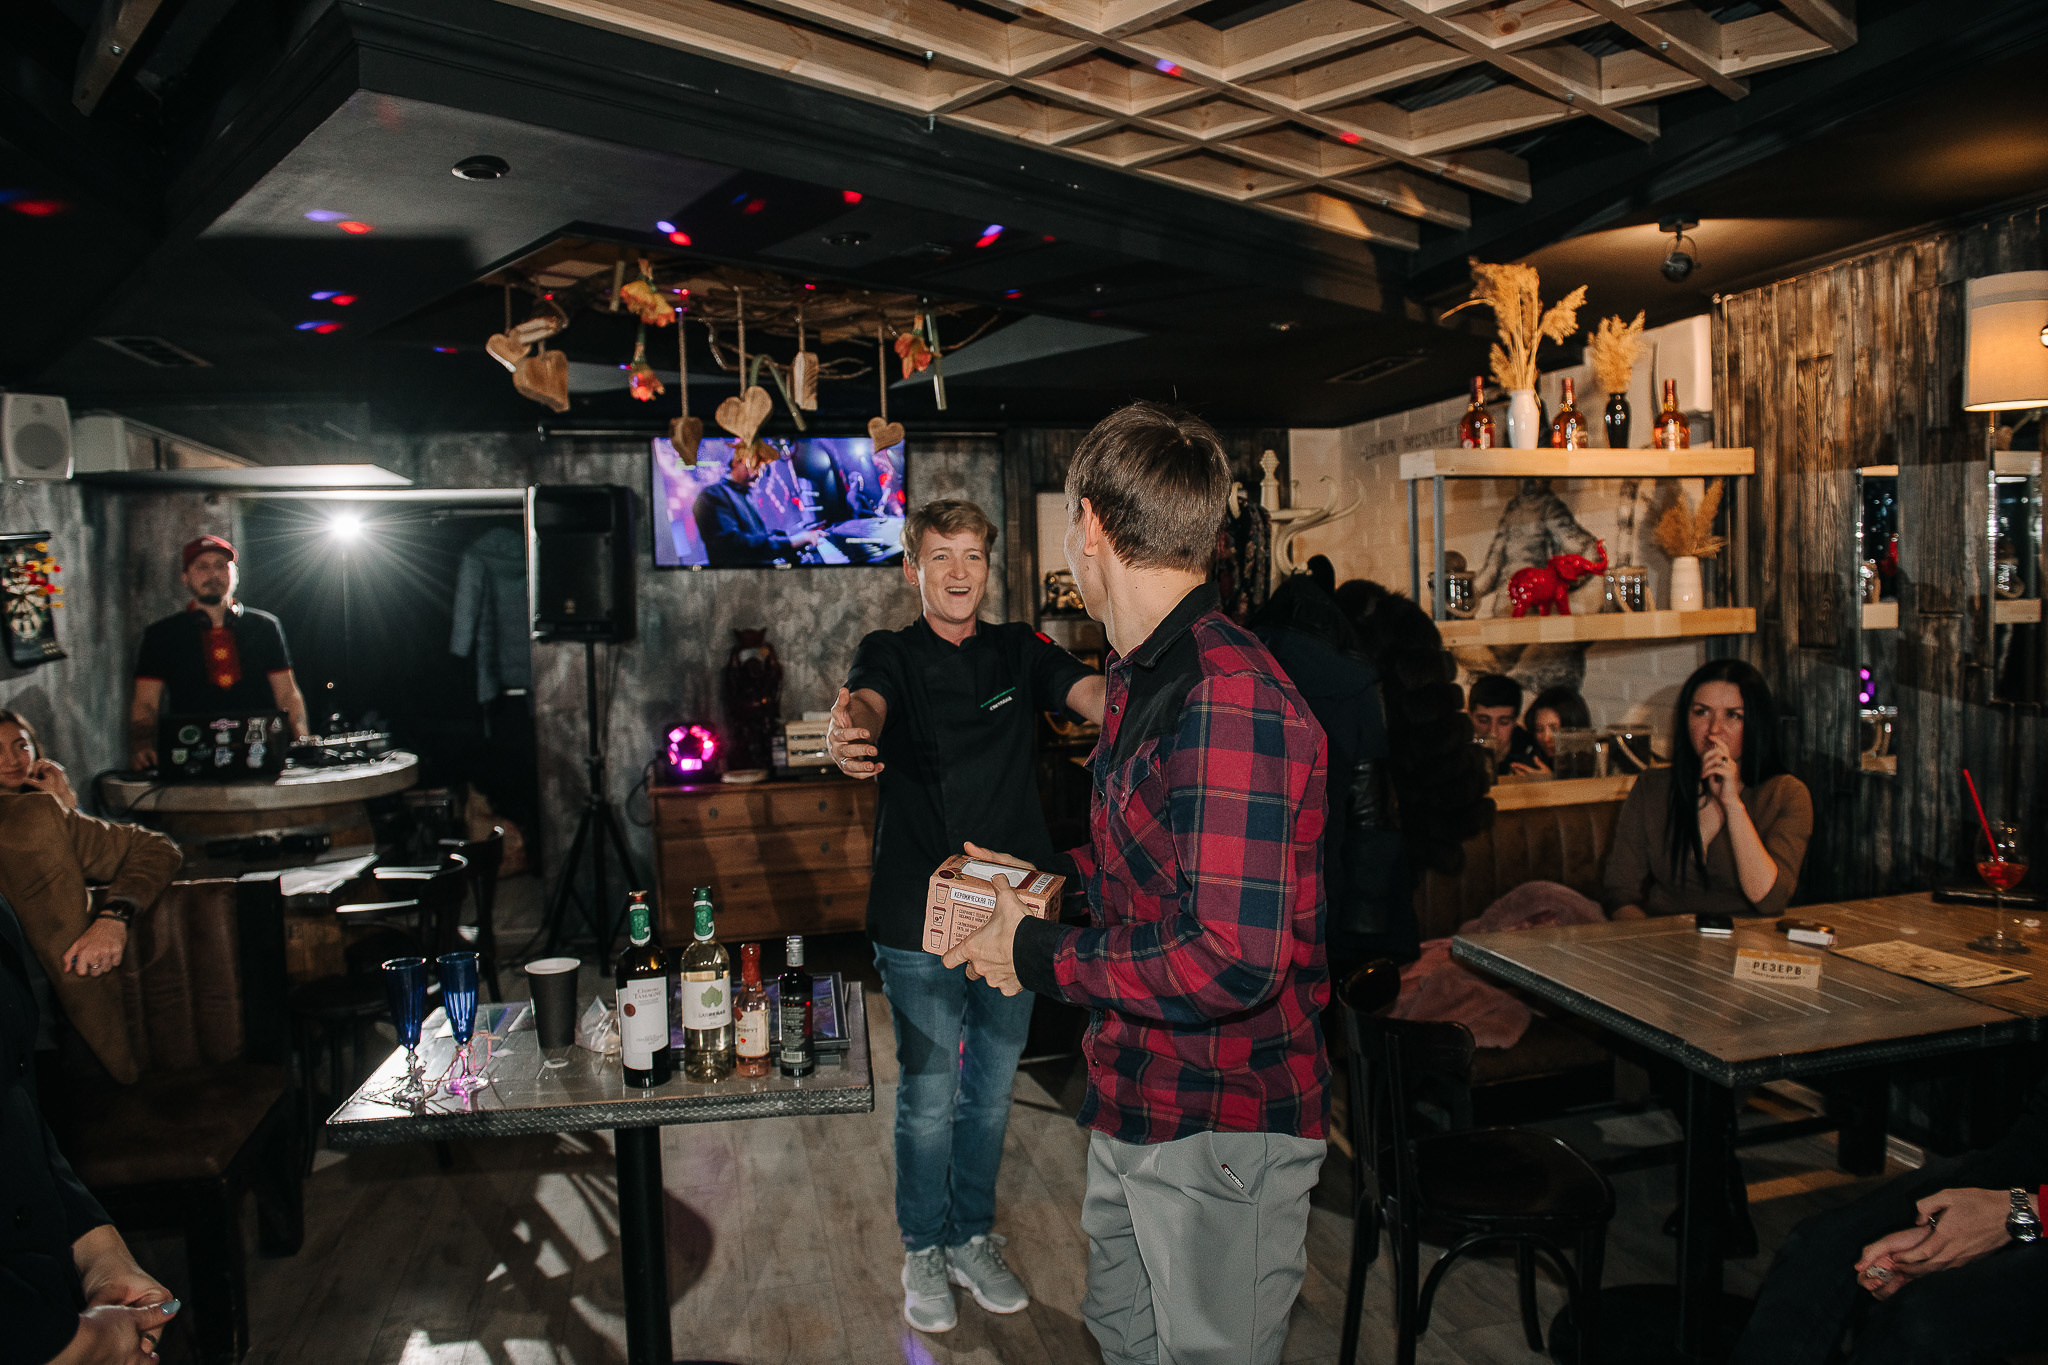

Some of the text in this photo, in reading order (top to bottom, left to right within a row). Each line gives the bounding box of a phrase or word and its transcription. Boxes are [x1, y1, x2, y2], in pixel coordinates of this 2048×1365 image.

[954, 891, 996, 907] КЕРАМИЧЕСКАЯ ТЕР
[1753, 961, 1802, 976] РЕЗЕРВ
